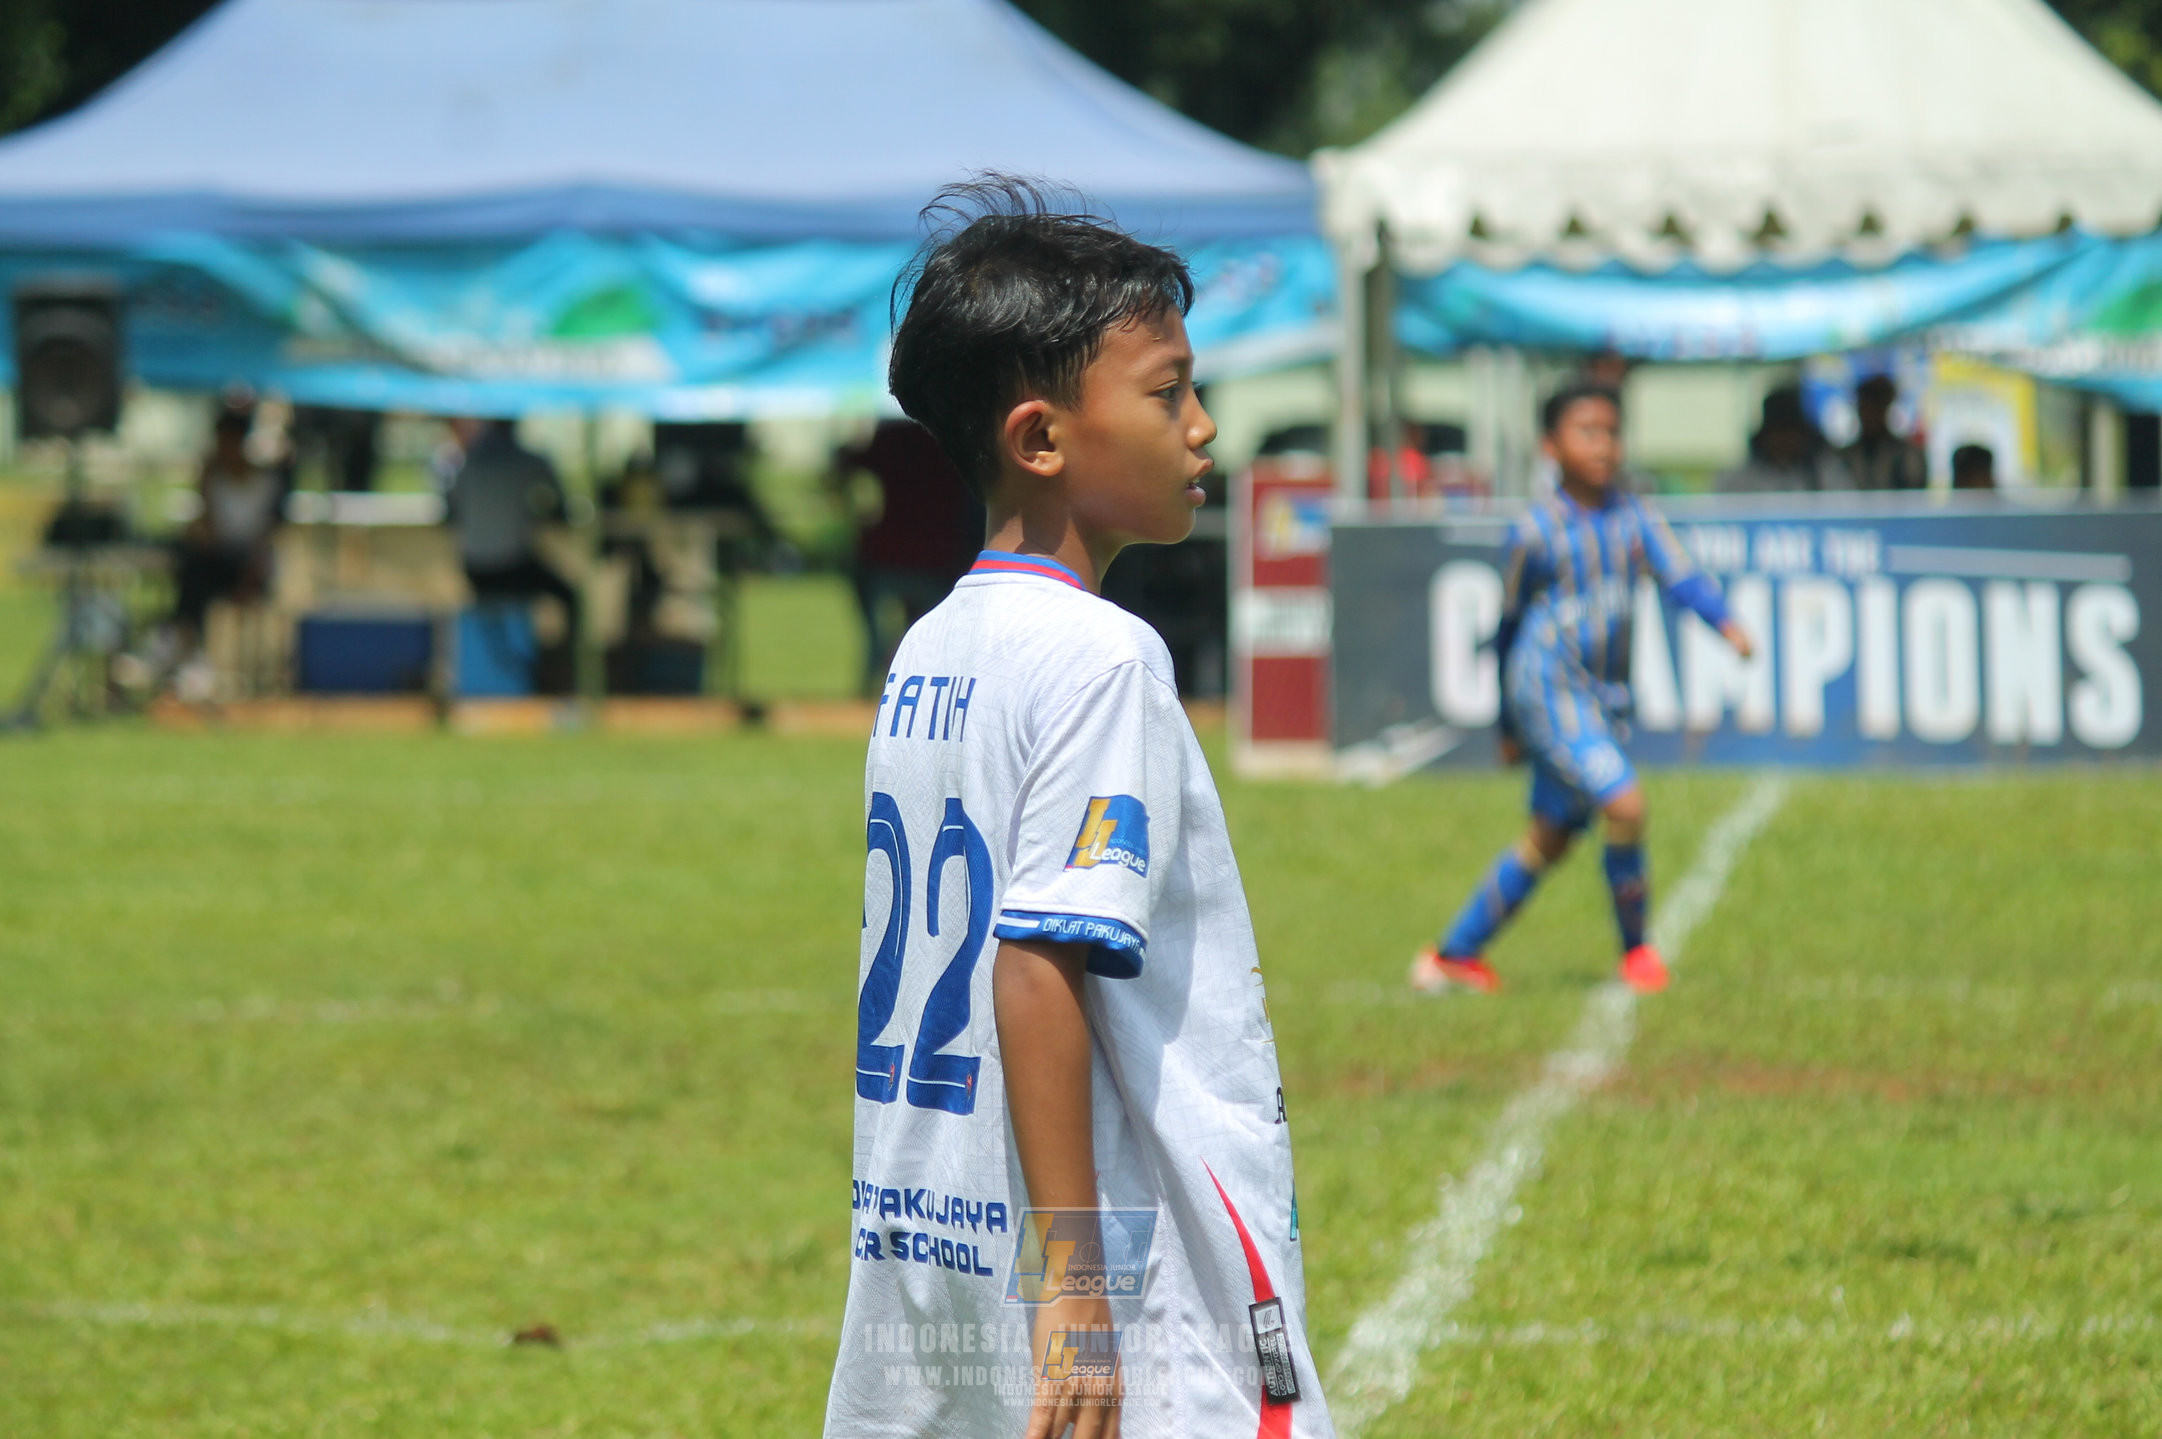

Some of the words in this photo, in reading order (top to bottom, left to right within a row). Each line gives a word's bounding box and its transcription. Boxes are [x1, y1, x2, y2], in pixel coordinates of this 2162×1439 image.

[1429, 560, 2142, 749] CAMPIONS
[1090, 842, 1147, 873] League
[1043, 917, 1085, 936] DIKLAT
[856, 791, 994, 1116] 22
[889, 1231, 994, 1277] SCHOOL
